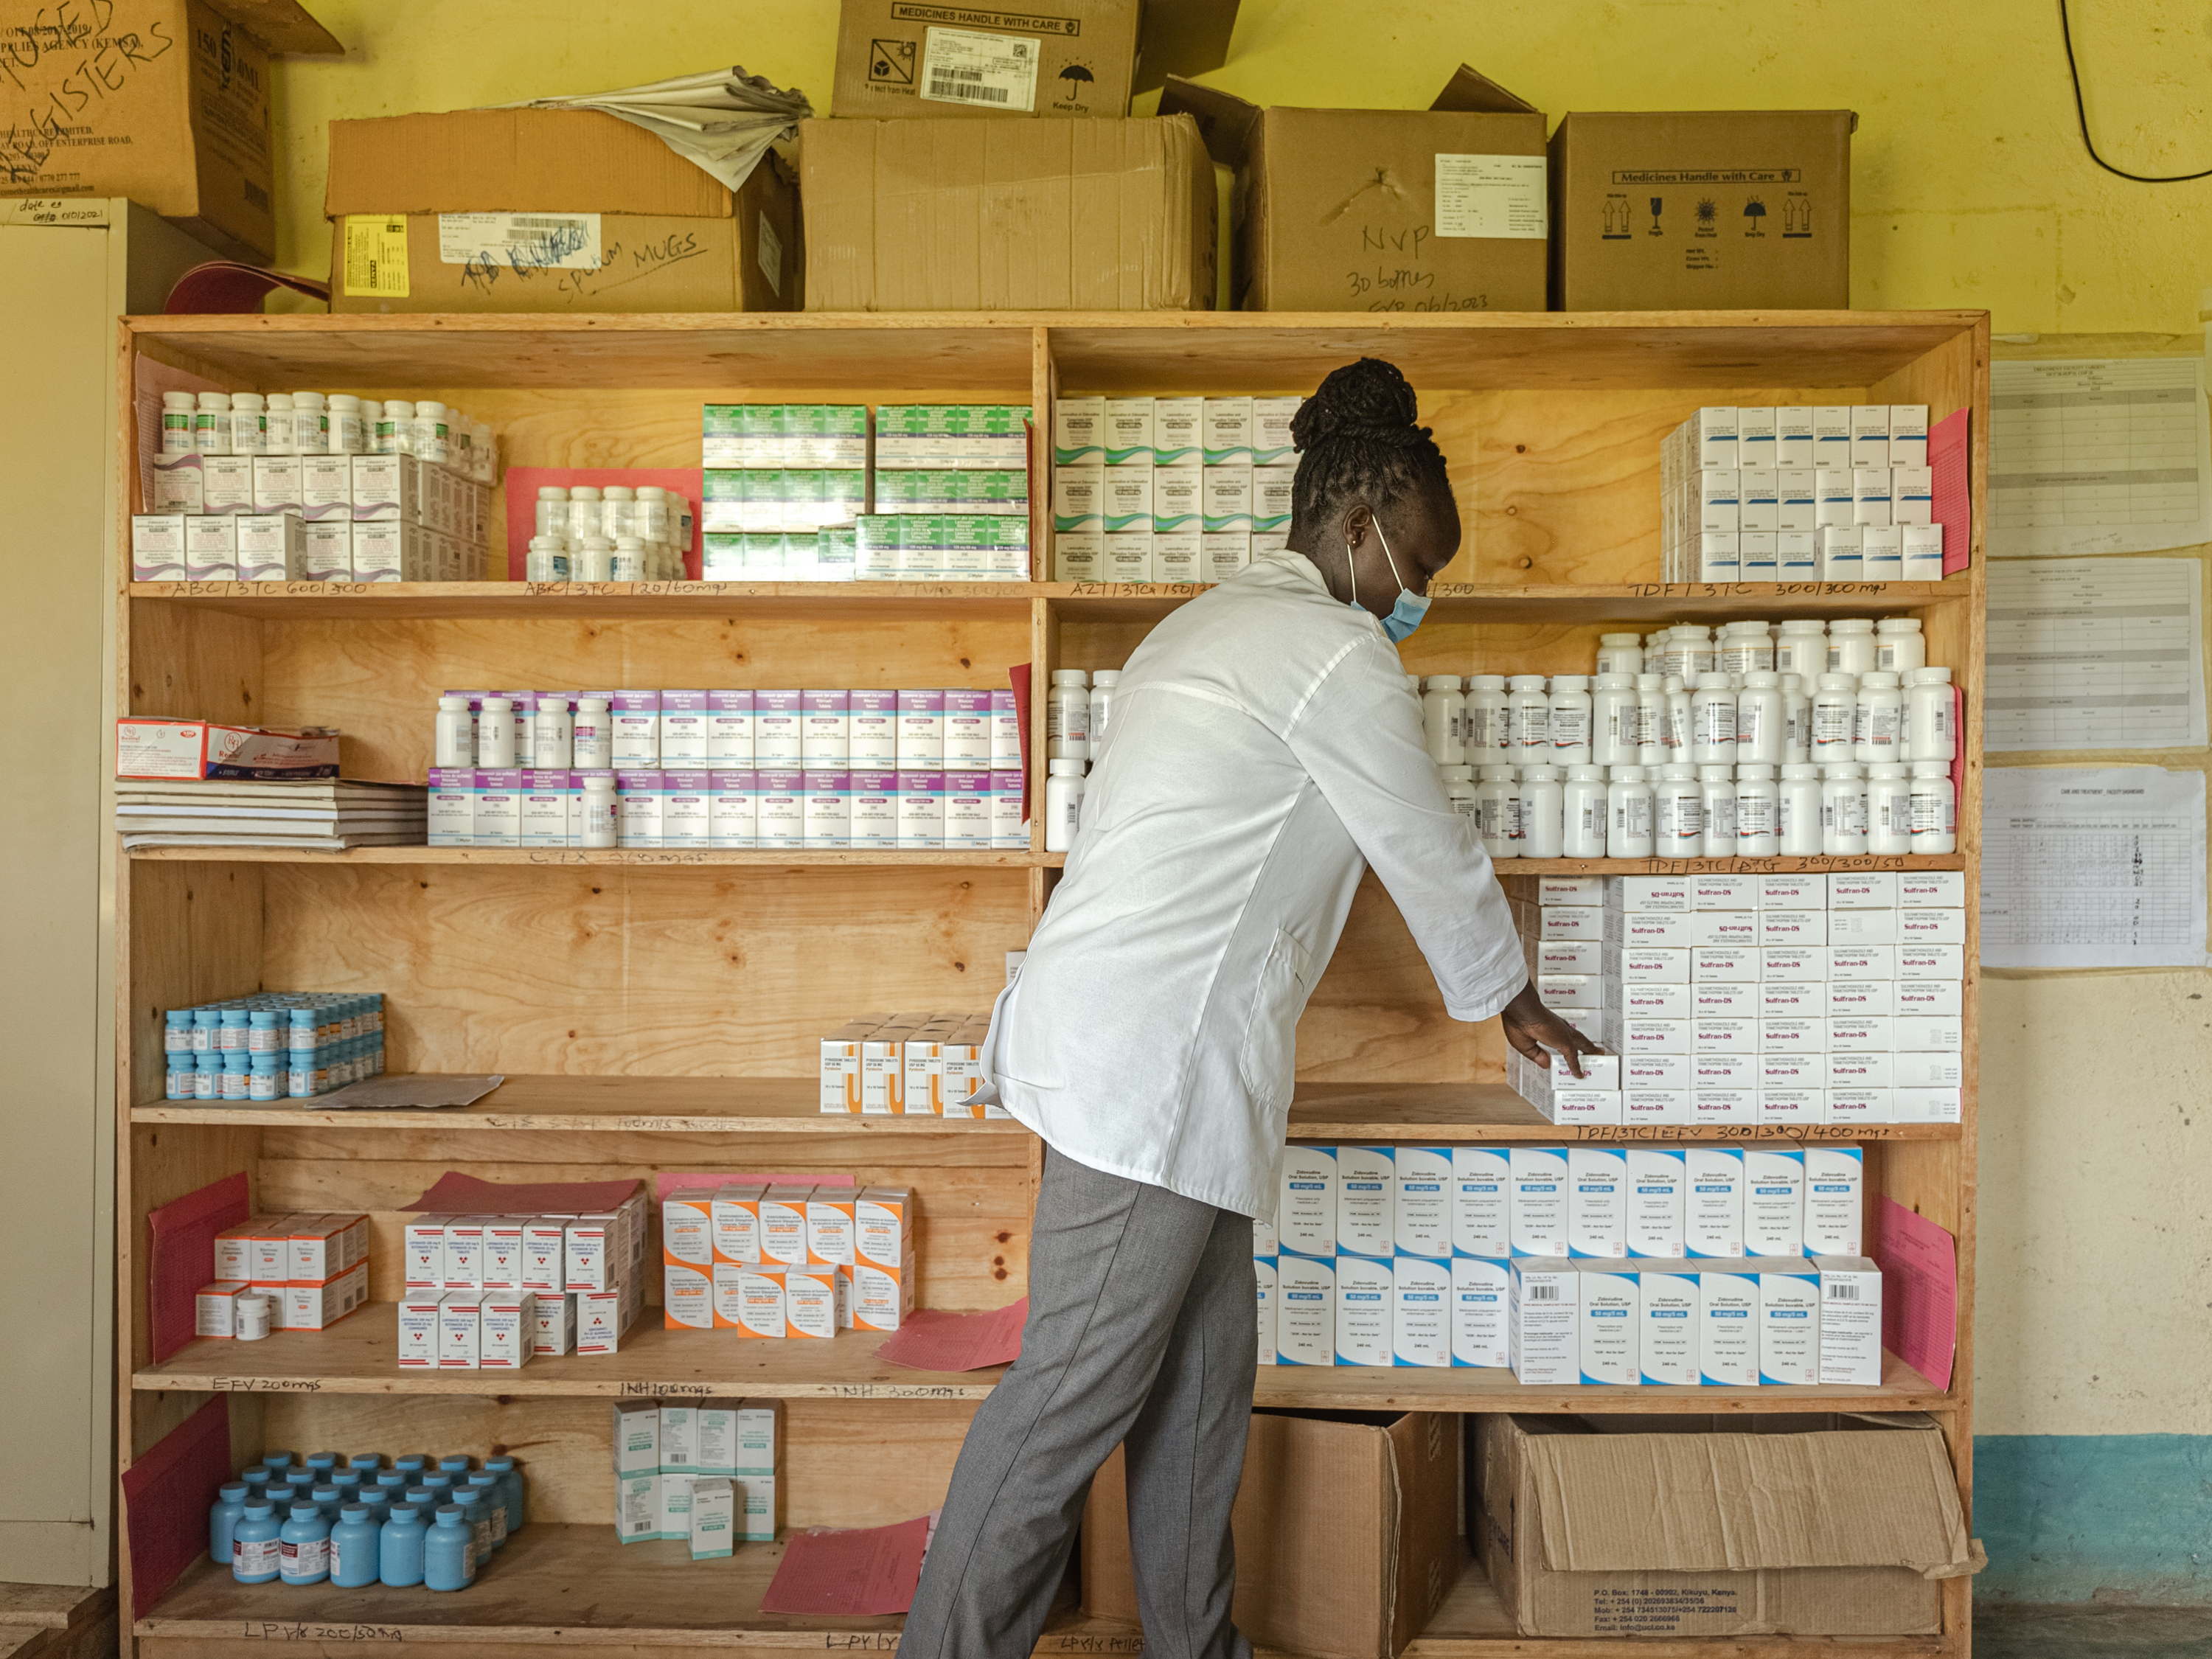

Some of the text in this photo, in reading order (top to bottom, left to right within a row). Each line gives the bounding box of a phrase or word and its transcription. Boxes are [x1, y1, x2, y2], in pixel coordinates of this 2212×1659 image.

[899, 7, 1061, 31] MEDICINES HANDLE WITH CARE
[1053, 101, 1089, 114] Keep Dry
[1621, 172, 1775, 182] Medicines Handle with Care
[633, 232, 698, 268] MUGS
[1363, 225, 1429, 260] NVP
[1346, 272, 1371, 297] 30
[212, 1377, 256, 1392] EFV
[620, 1382, 649, 1396] INH
